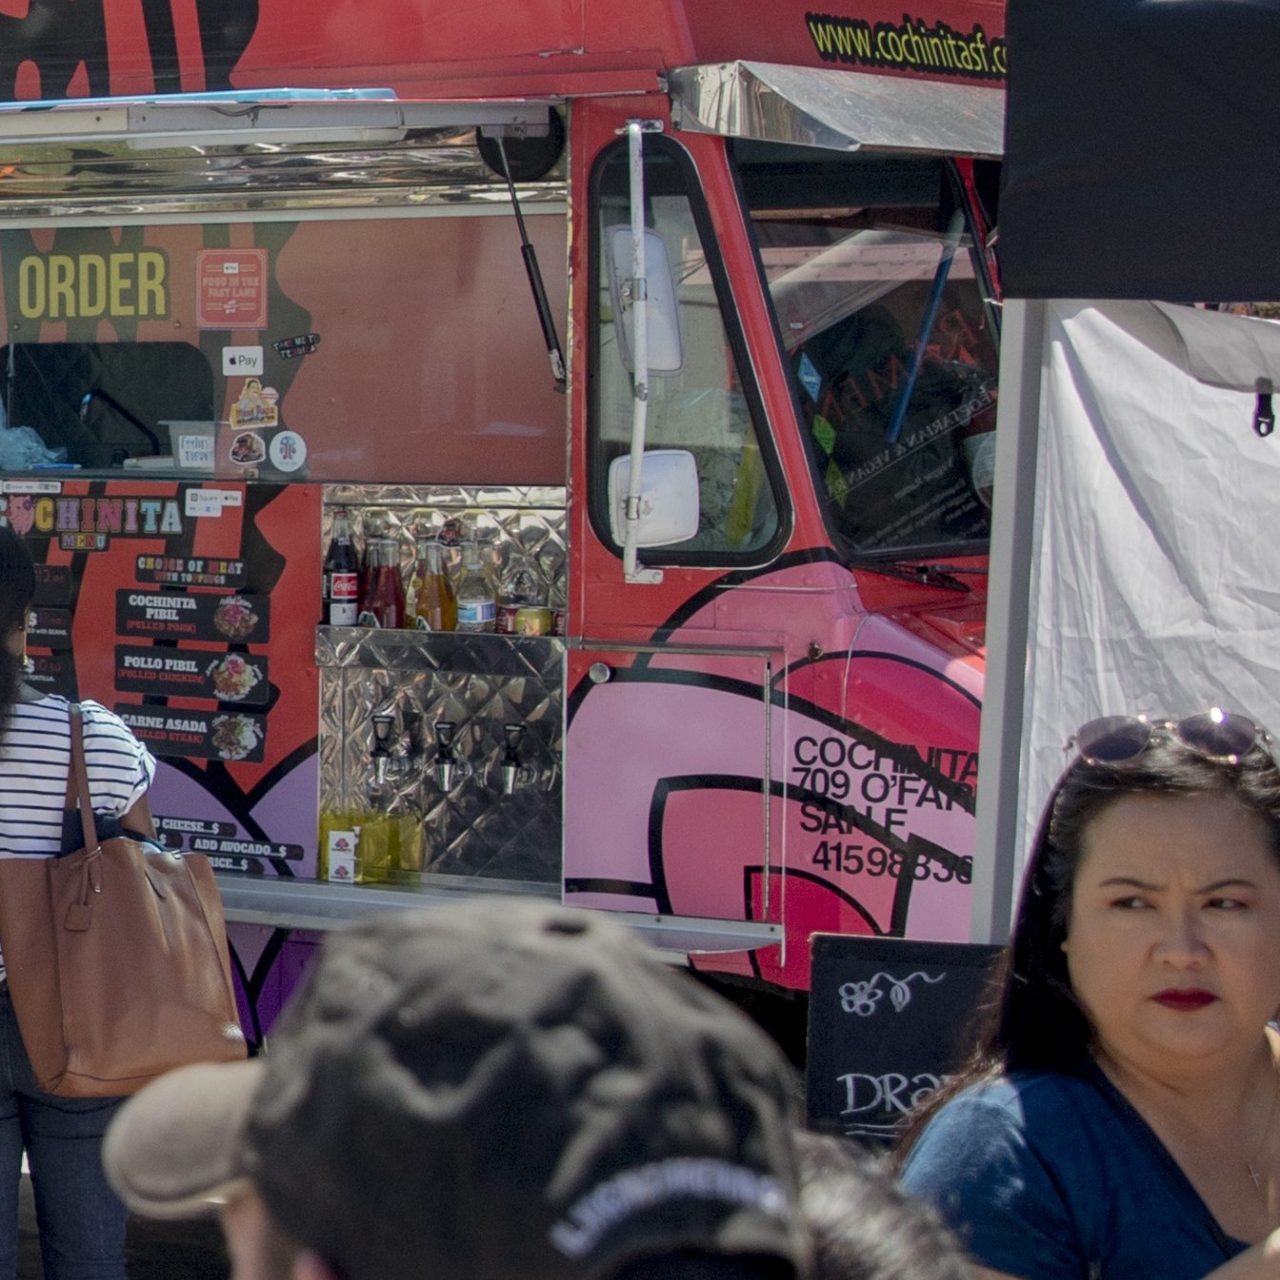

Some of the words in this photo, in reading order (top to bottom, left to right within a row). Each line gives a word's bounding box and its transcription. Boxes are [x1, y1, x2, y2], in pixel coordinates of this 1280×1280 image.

[19, 252, 166, 319] ORDER
[202, 277, 227, 287] FOOD
[228, 277, 240, 287] IN
[241, 277, 260, 287] THE
[233, 287, 256, 298] LANE
[238, 354, 258, 368] Pay
[62, 533, 107, 549] MENU
[137, 557, 184, 571] CHOICE
[187, 560, 204, 572] OF
[207, 561, 244, 575] MEAT
[128, 594, 197, 610] COCHINITA
[145, 608, 180, 621] PIBIL
[123, 655, 163, 669] POLLO
[164, 659, 199, 673] PIBIL
[165, 718, 208, 734] ASADA
[791, 766, 851, 800] 709
[194, 838, 218, 851] ADD
